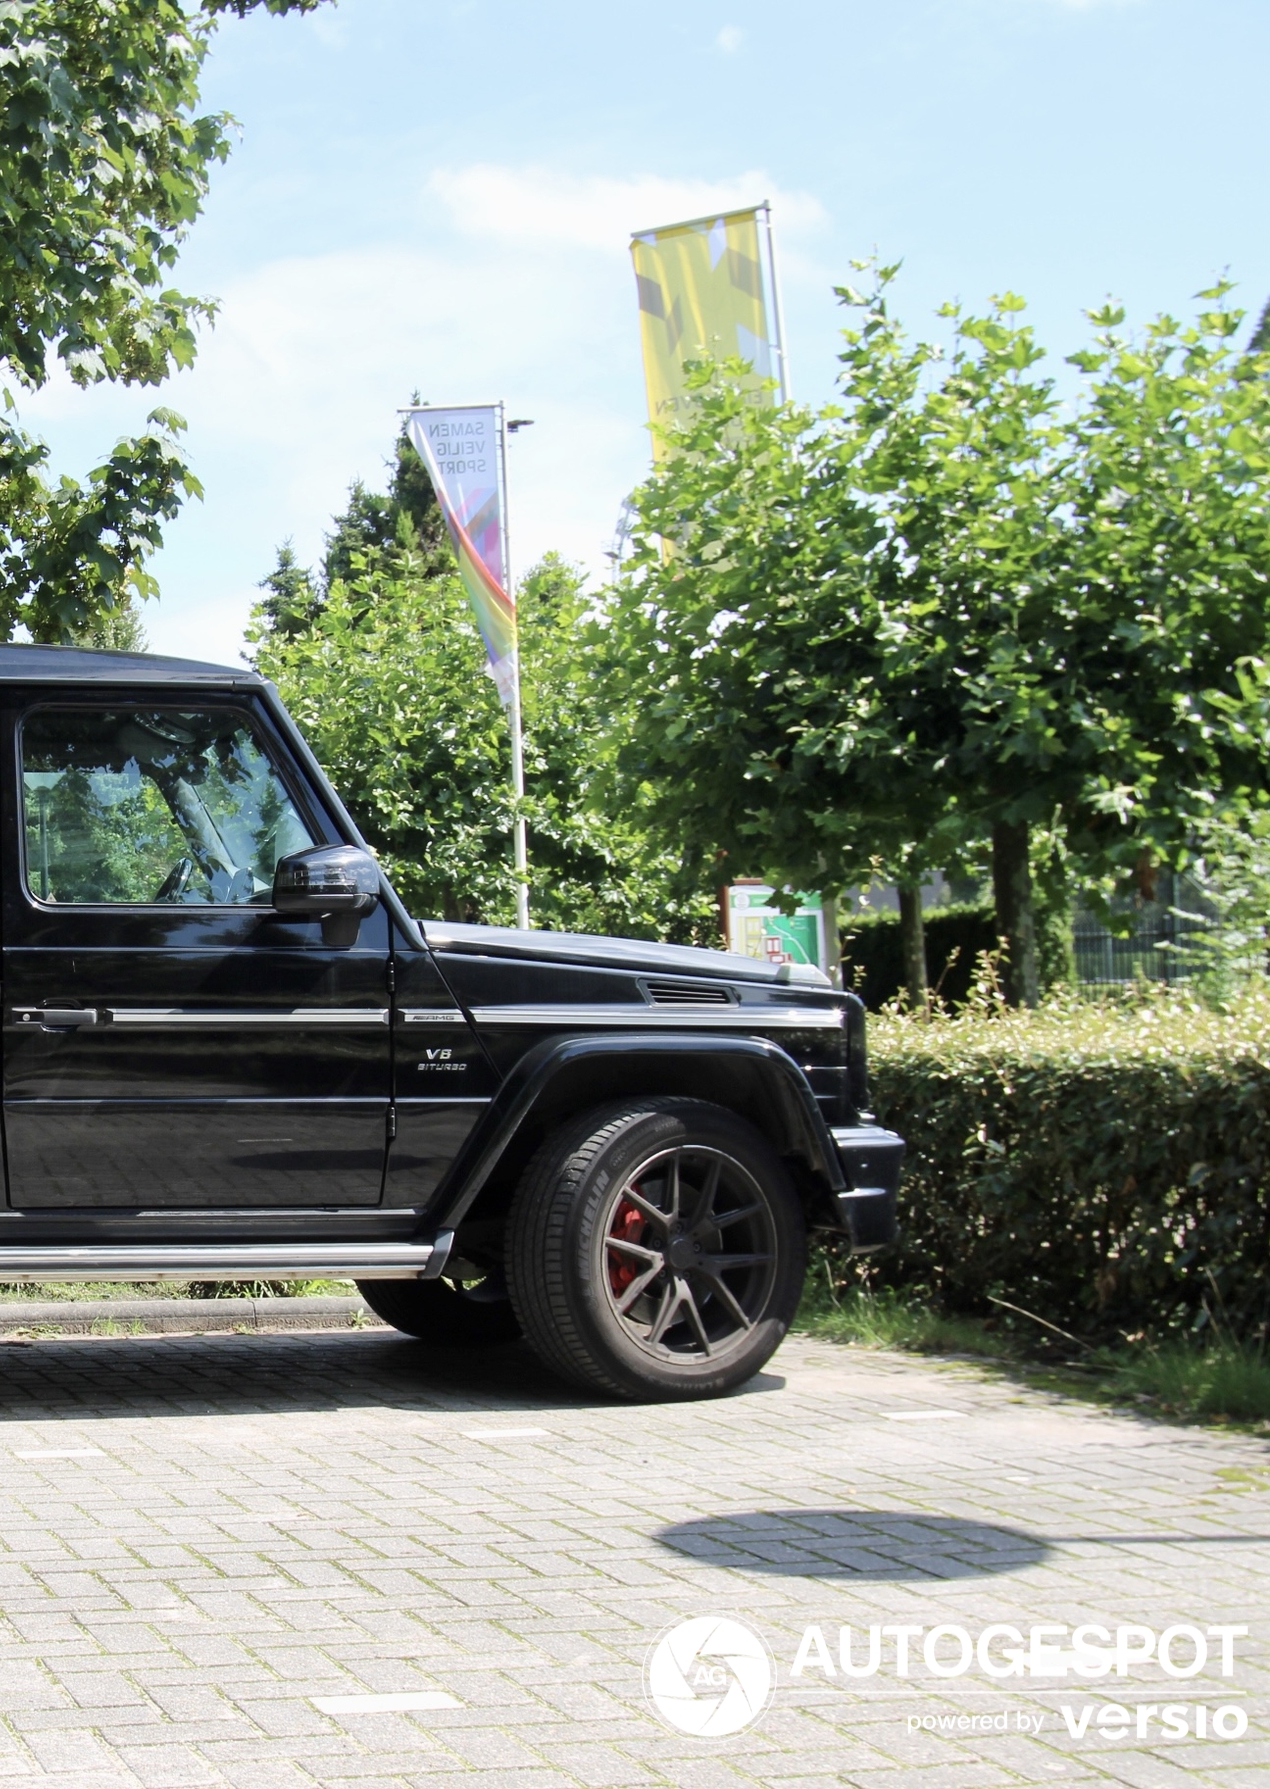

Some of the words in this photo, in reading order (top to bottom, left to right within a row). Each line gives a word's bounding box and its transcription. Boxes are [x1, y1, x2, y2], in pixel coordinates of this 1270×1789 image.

[425, 1048, 453, 1060] V8
[417, 1063, 468, 1071] BITURBO
[578, 1169, 610, 1280] MICHELIN
